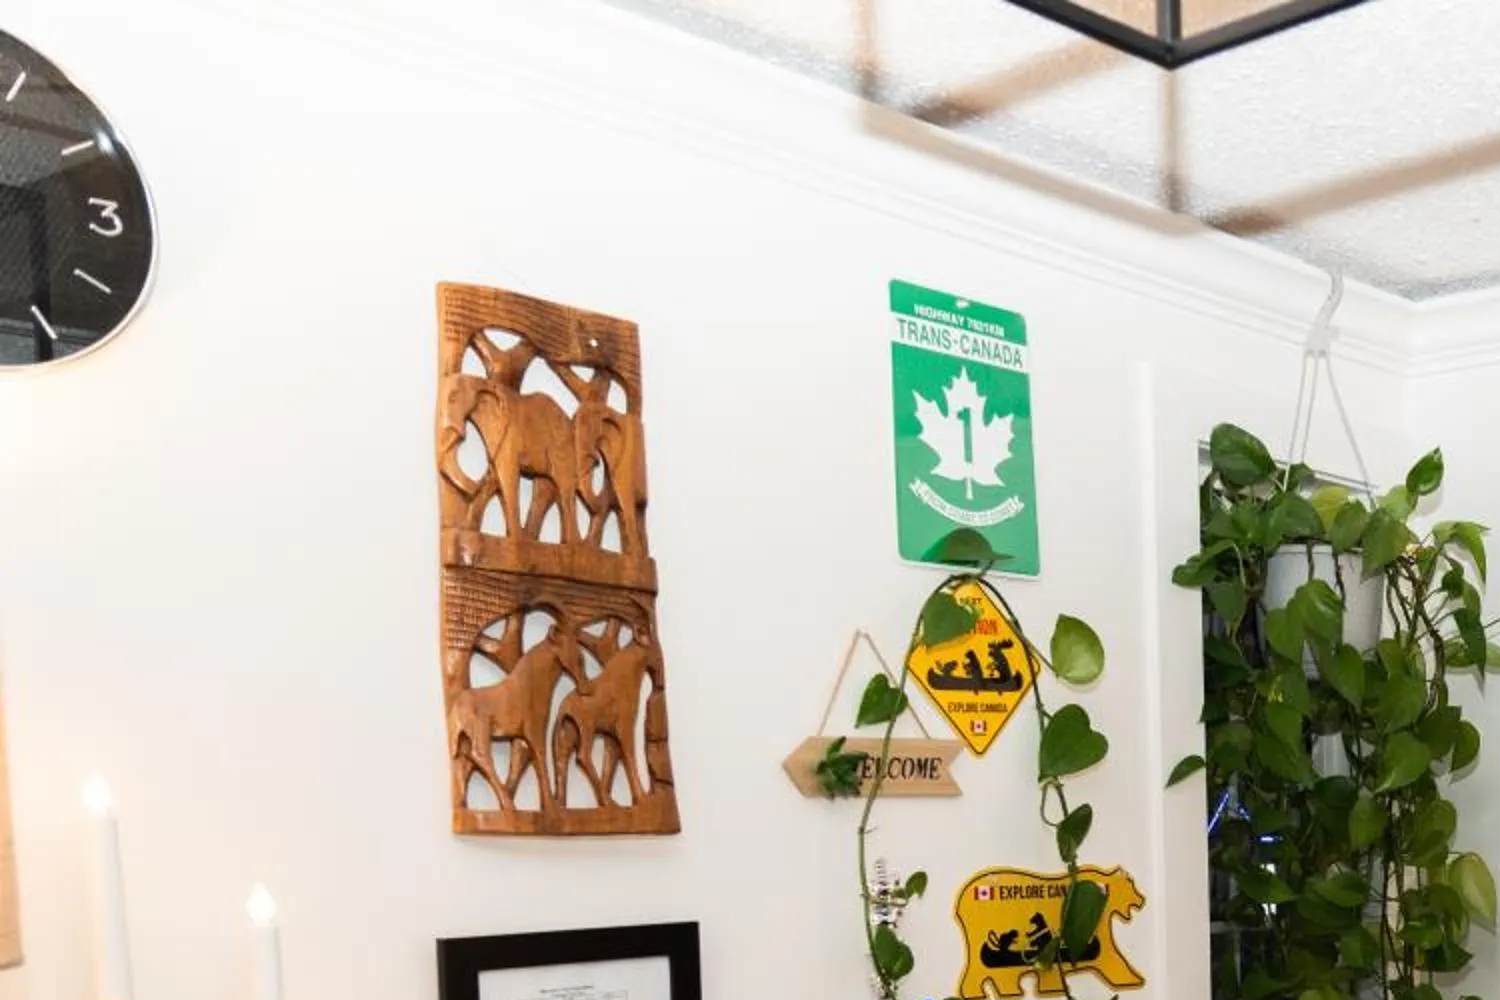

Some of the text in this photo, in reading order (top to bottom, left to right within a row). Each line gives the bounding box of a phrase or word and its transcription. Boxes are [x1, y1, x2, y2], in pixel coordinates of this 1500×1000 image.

[88, 196, 124, 238] 3
[896, 317, 1024, 369] TRANS-CANADA
[956, 407, 974, 465] 1
[861, 756, 942, 780] ELCOME
[1000, 884, 1045, 900] EXPLORE
